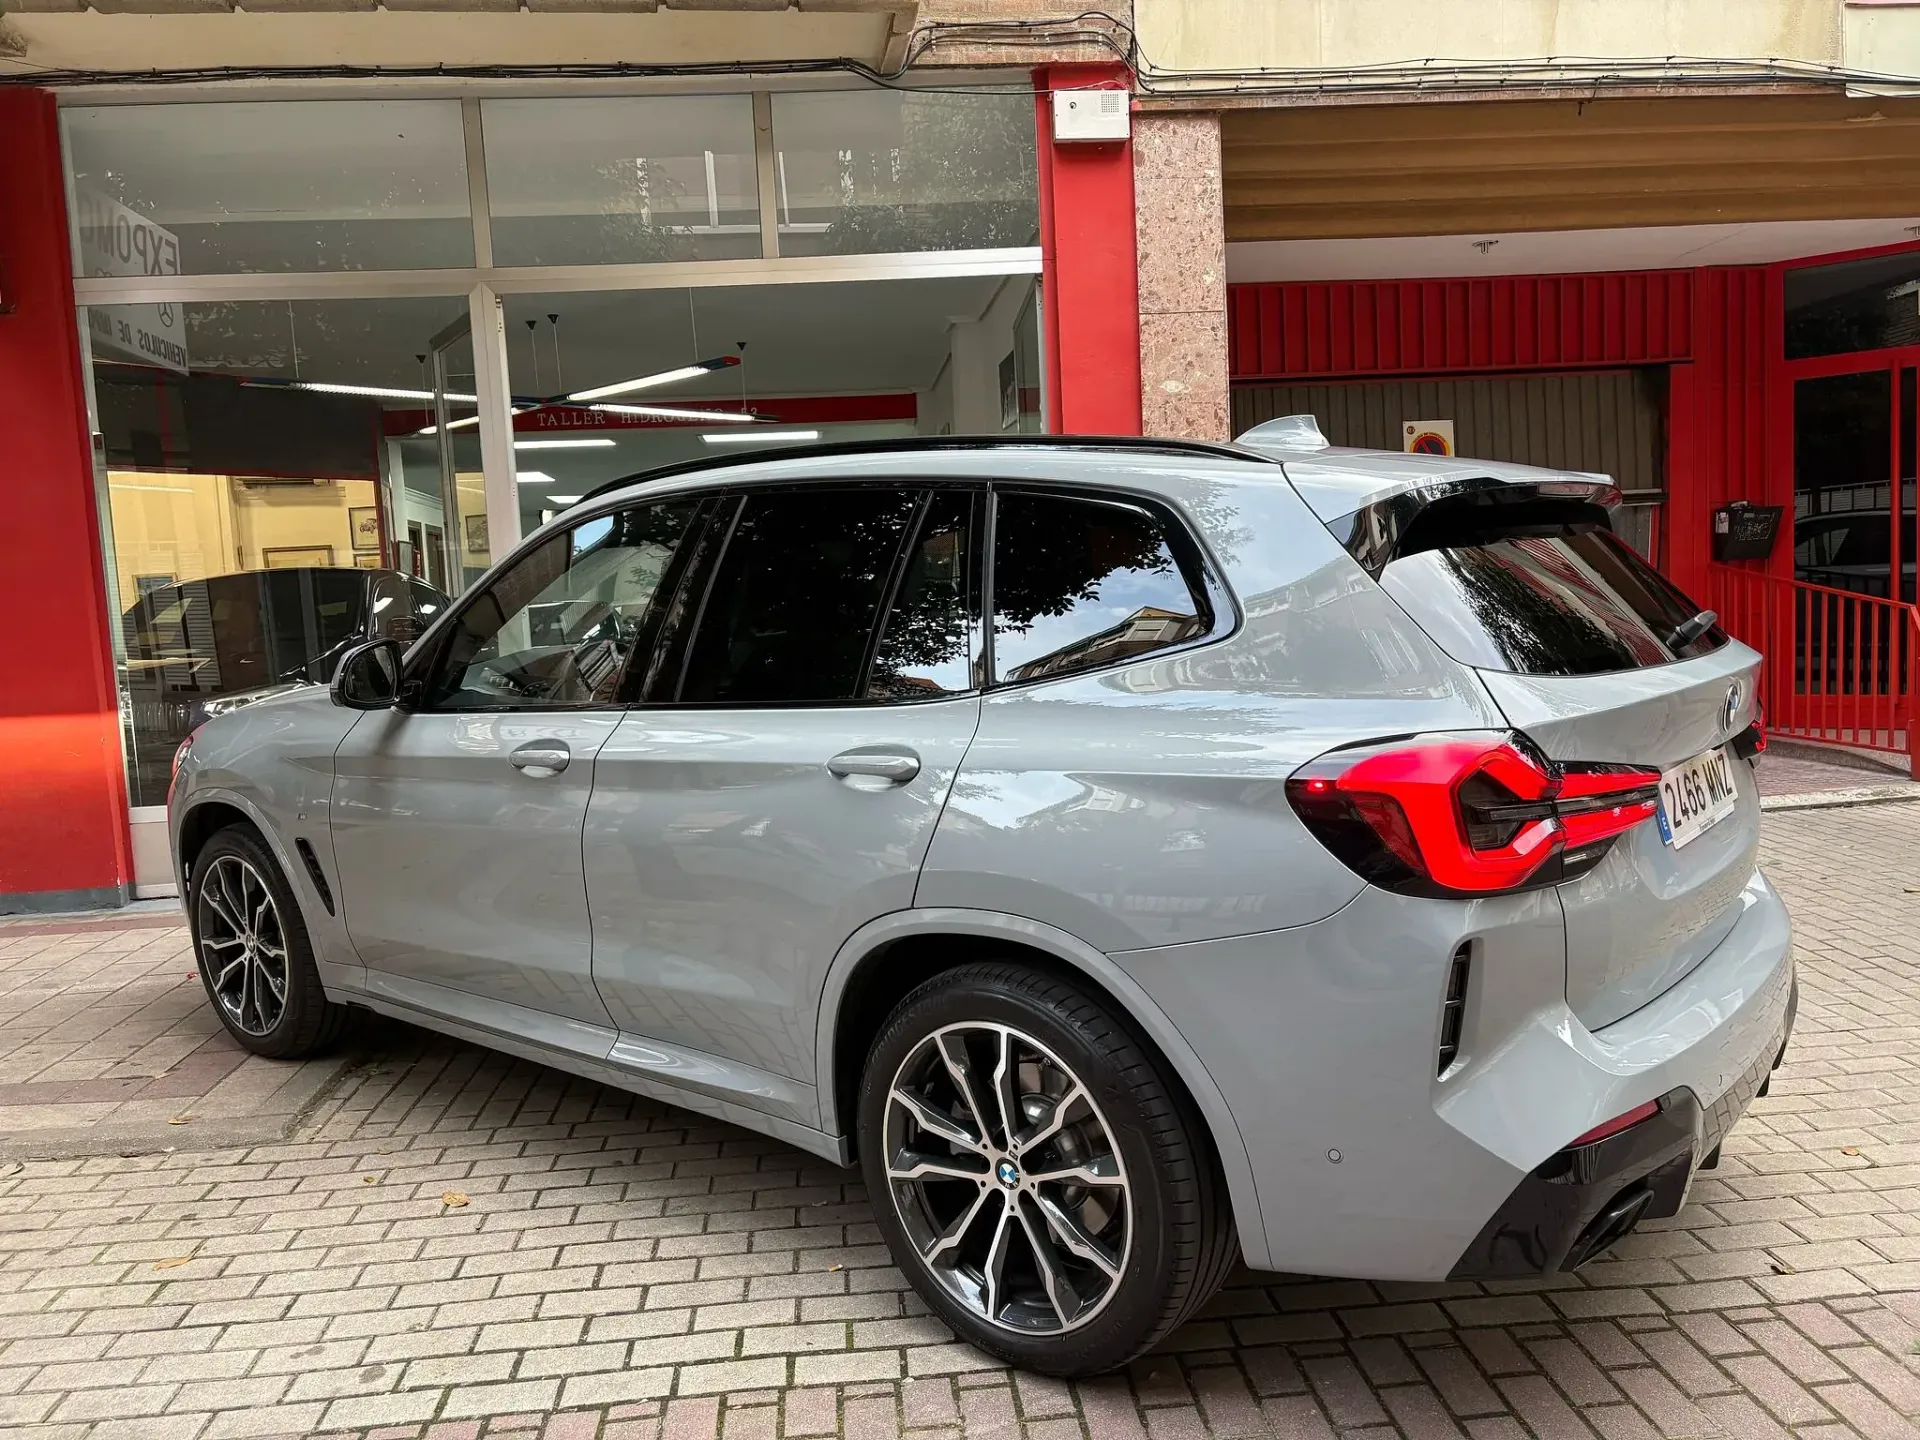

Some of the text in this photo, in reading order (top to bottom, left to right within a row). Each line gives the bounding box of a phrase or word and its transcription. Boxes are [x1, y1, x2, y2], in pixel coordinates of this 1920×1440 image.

[537, 411, 606, 426] TALLER
[1665, 754, 1733, 829] 2466 MNZ
